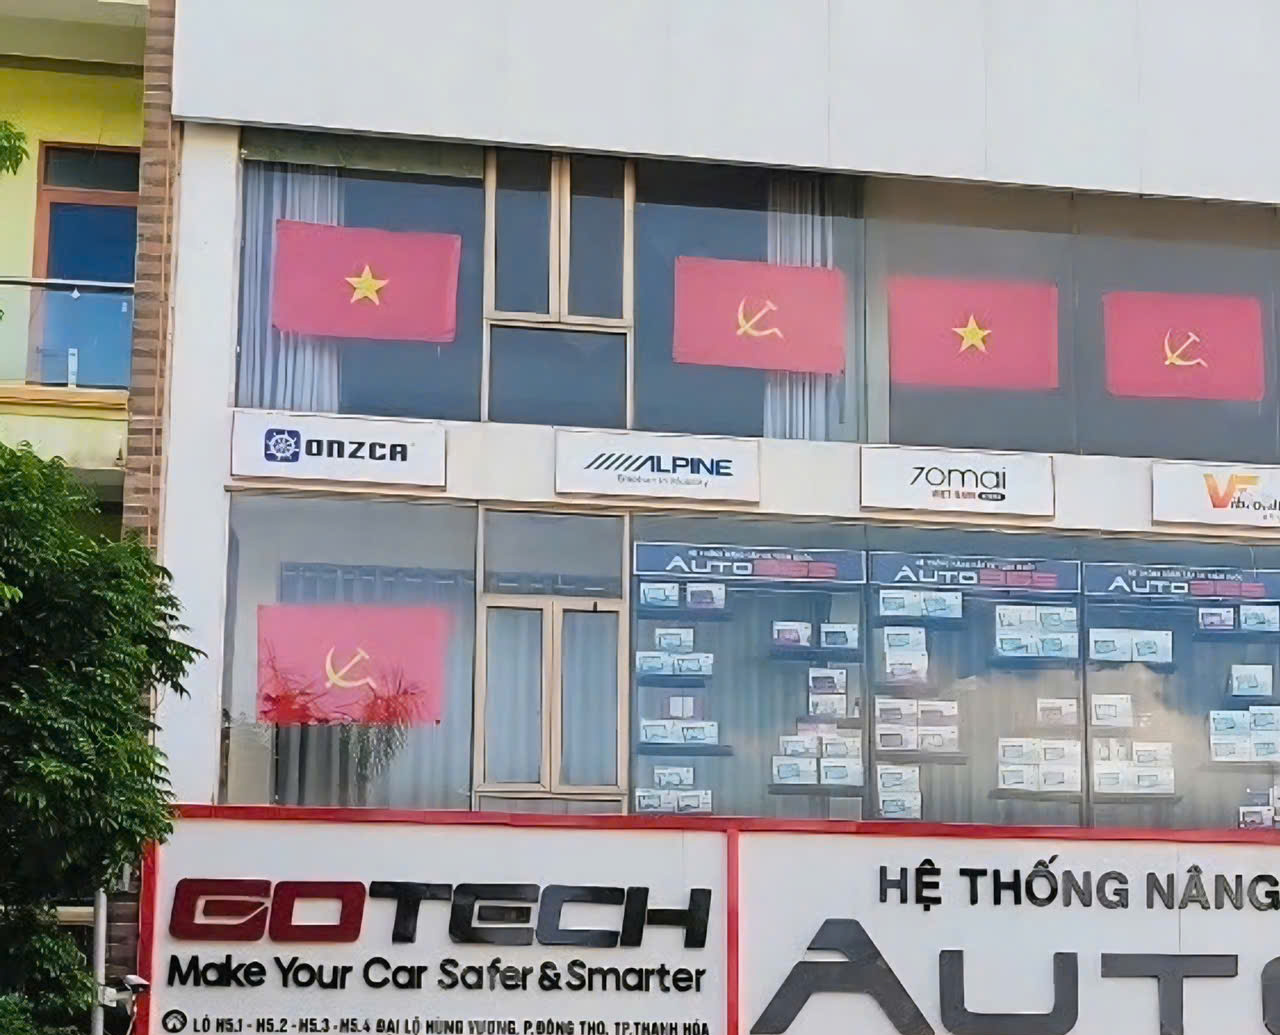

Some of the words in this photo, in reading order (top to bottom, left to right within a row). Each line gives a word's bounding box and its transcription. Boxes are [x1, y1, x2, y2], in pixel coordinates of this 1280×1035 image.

[625, 454, 733, 477] ALPINE
[910, 466, 1006, 490] 70mai
[878, 858, 943, 913] HỆ
[958, 853, 1129, 910] THỐNG
[168, 877, 712, 949] GOTECH
[166, 953, 267, 989] Make
[273, 957, 353, 991] Your
[362, 956, 428, 991] Car
